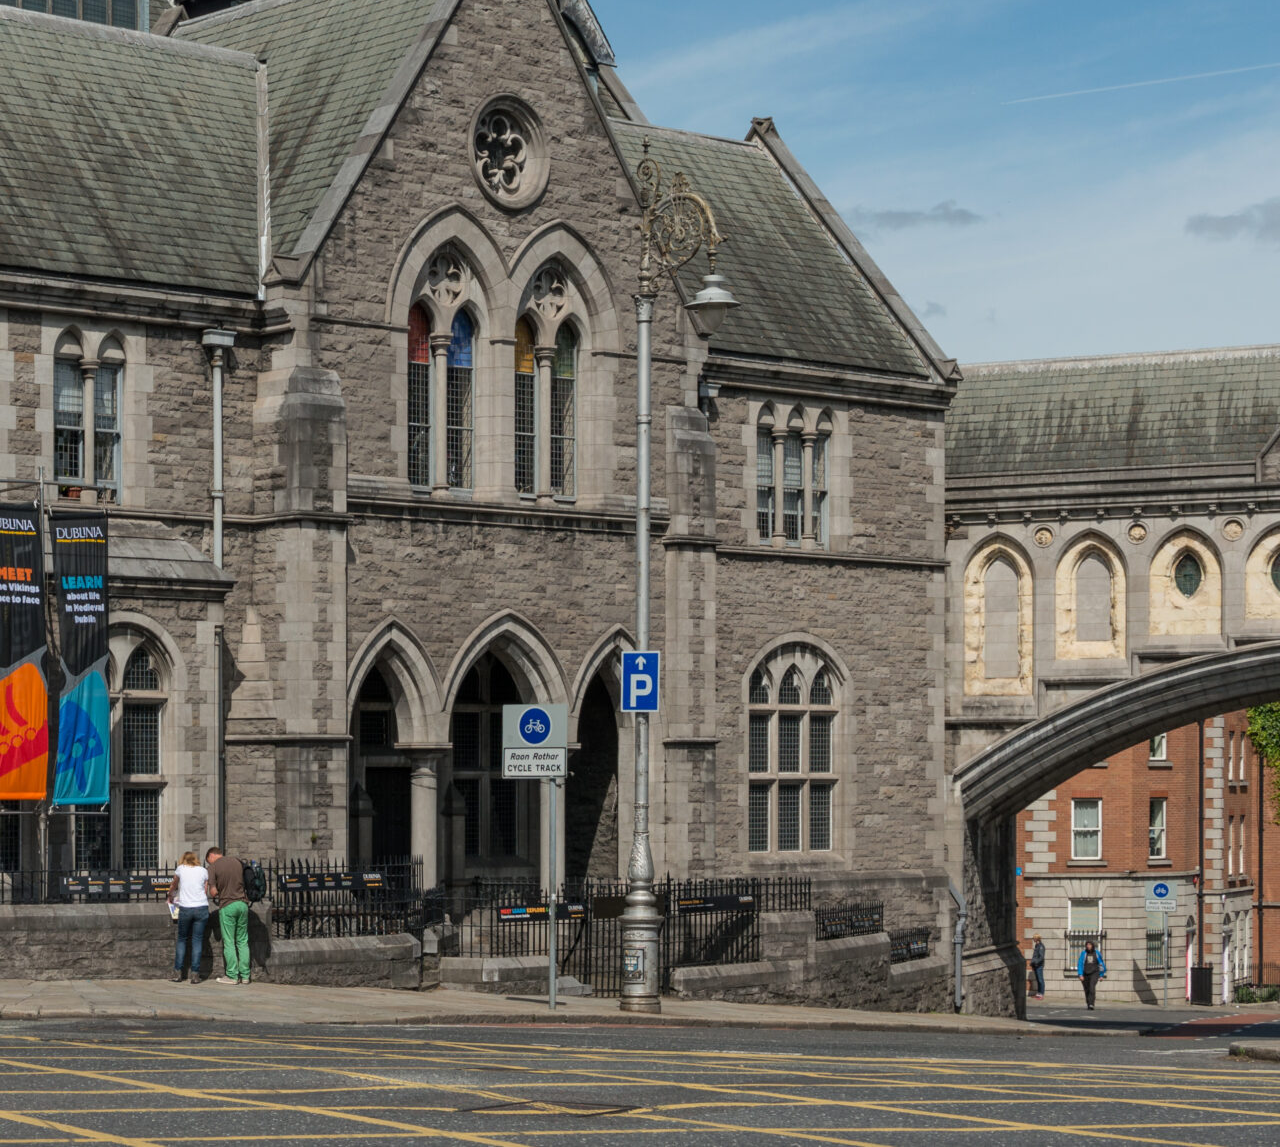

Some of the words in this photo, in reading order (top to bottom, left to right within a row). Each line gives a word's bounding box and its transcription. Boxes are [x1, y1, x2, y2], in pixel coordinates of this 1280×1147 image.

[56, 526, 104, 539] DUBLINIA
[62, 575, 103, 589] LEARN
[8, 583, 40, 593] Vikings
[11, 595, 21, 604] to
[22, 595, 40, 605] face
[66, 592, 88, 601] about
[73, 603, 105, 612] Medieval
[74, 614, 96, 623] Dublin
[630, 674, 652, 707] P
[510, 752, 530, 761] Raon
[532, 752, 559, 761] Rothar
[507, 764, 532, 772] CYCLE
[536, 764, 561, 772] TRACK
